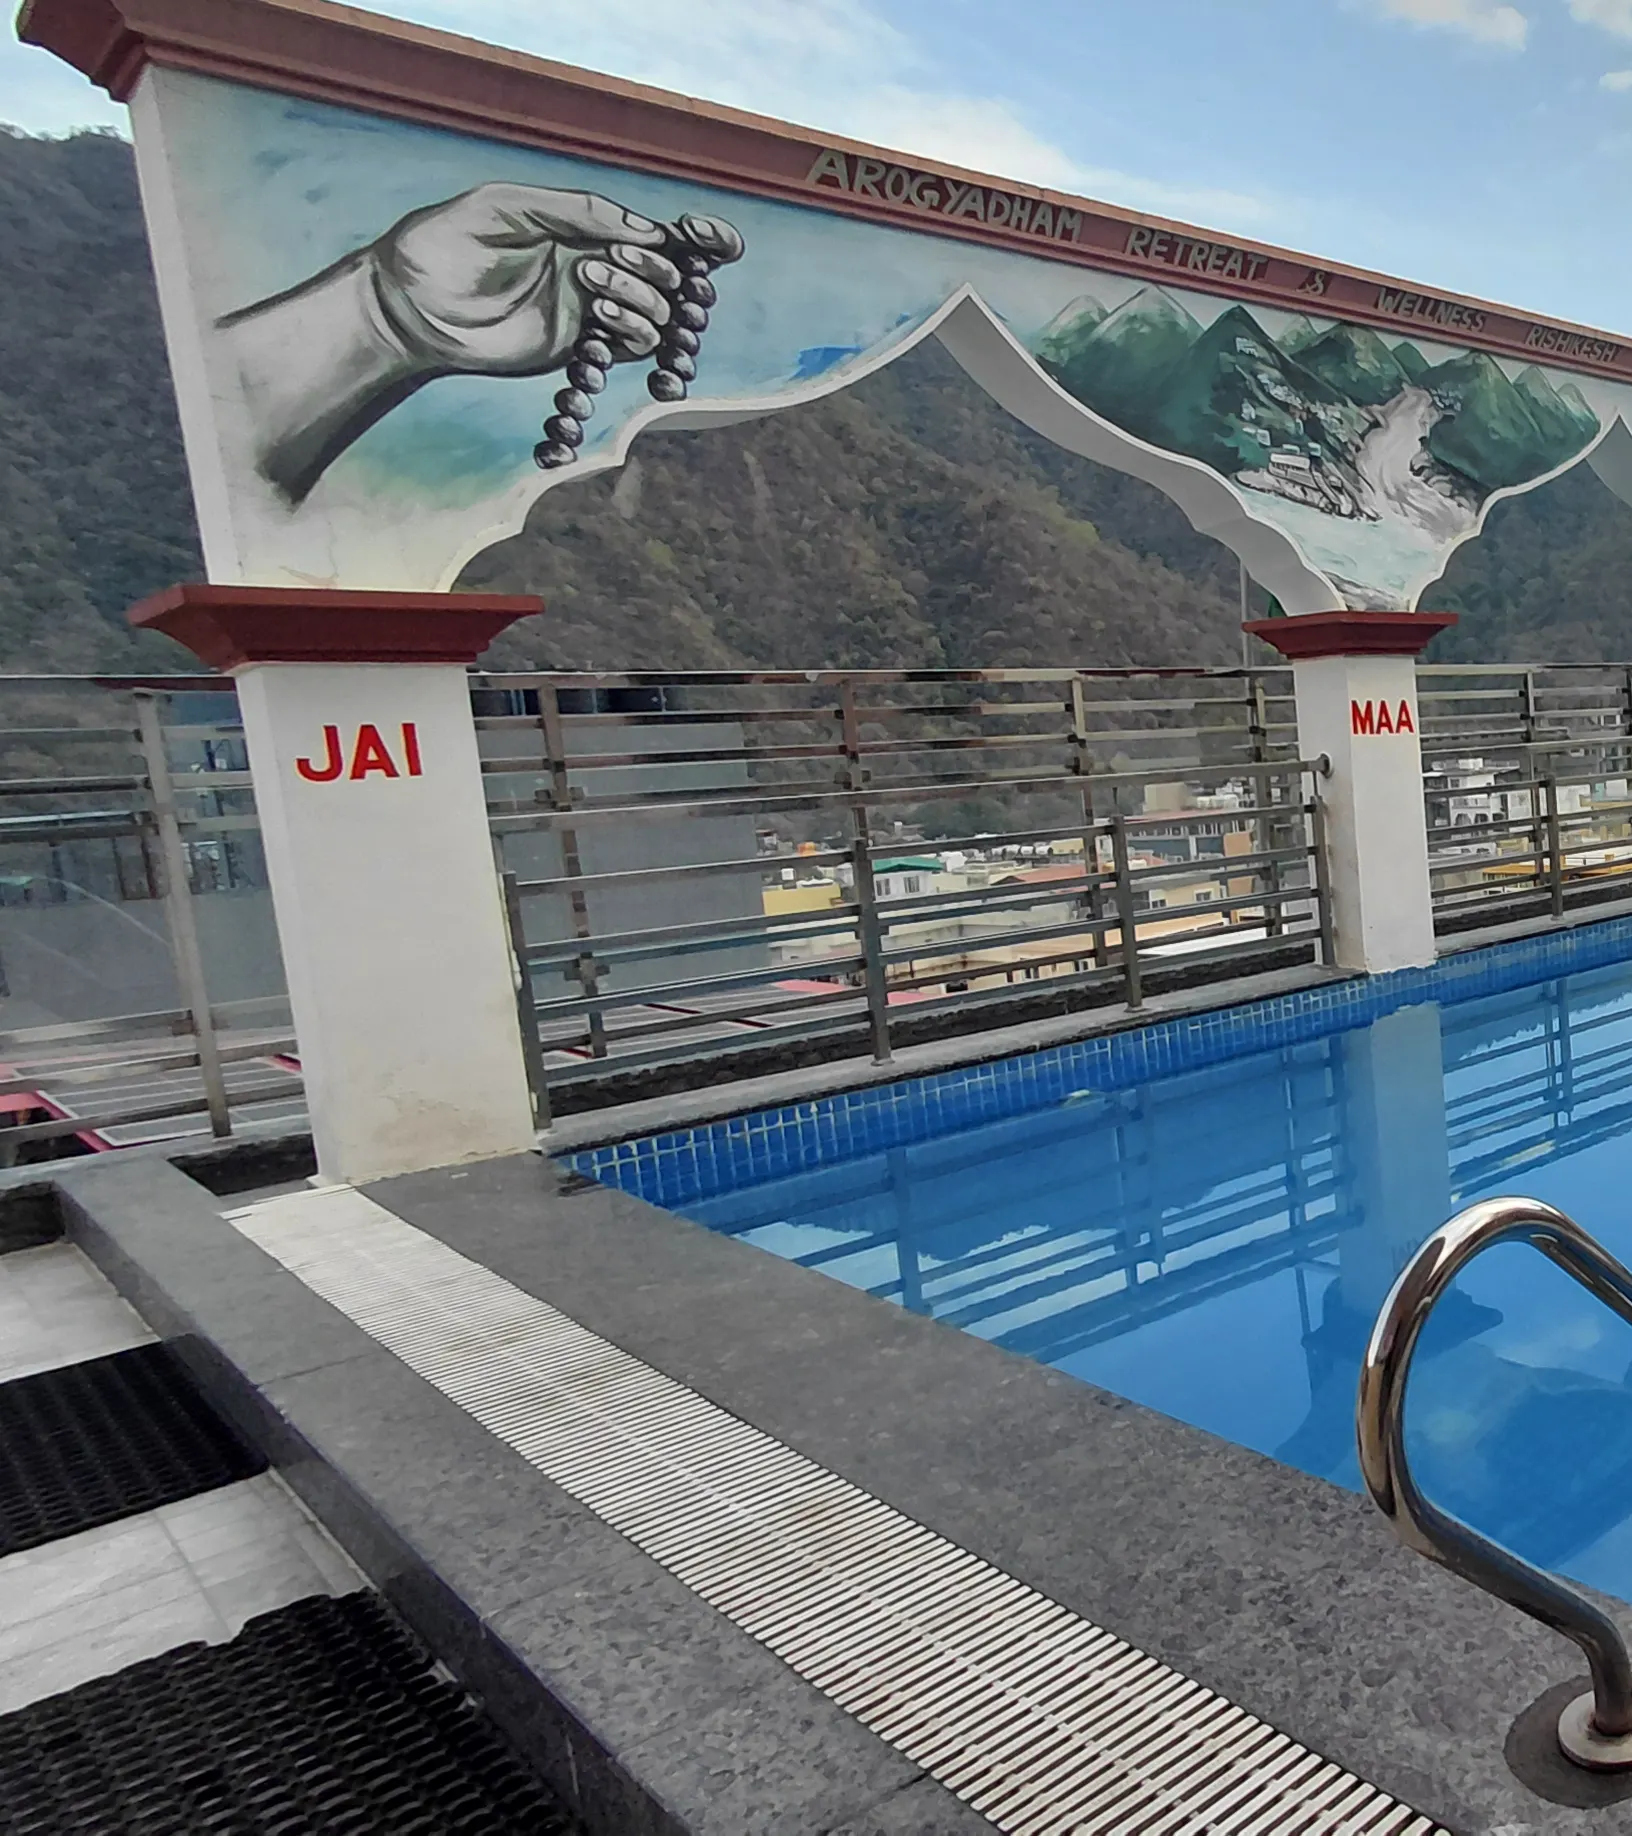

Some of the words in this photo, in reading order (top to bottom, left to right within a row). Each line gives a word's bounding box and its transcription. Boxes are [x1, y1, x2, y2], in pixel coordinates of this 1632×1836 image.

[805, 150, 1083, 242] AROGYADHAM
[1124, 227, 1267, 281] RETREAT
[1377, 288, 1487, 332] WELLNESS
[1526, 324, 1620, 362] RISHIKESH
[1350, 698, 1415, 735] MAA
[295, 721, 424, 784] JAI
